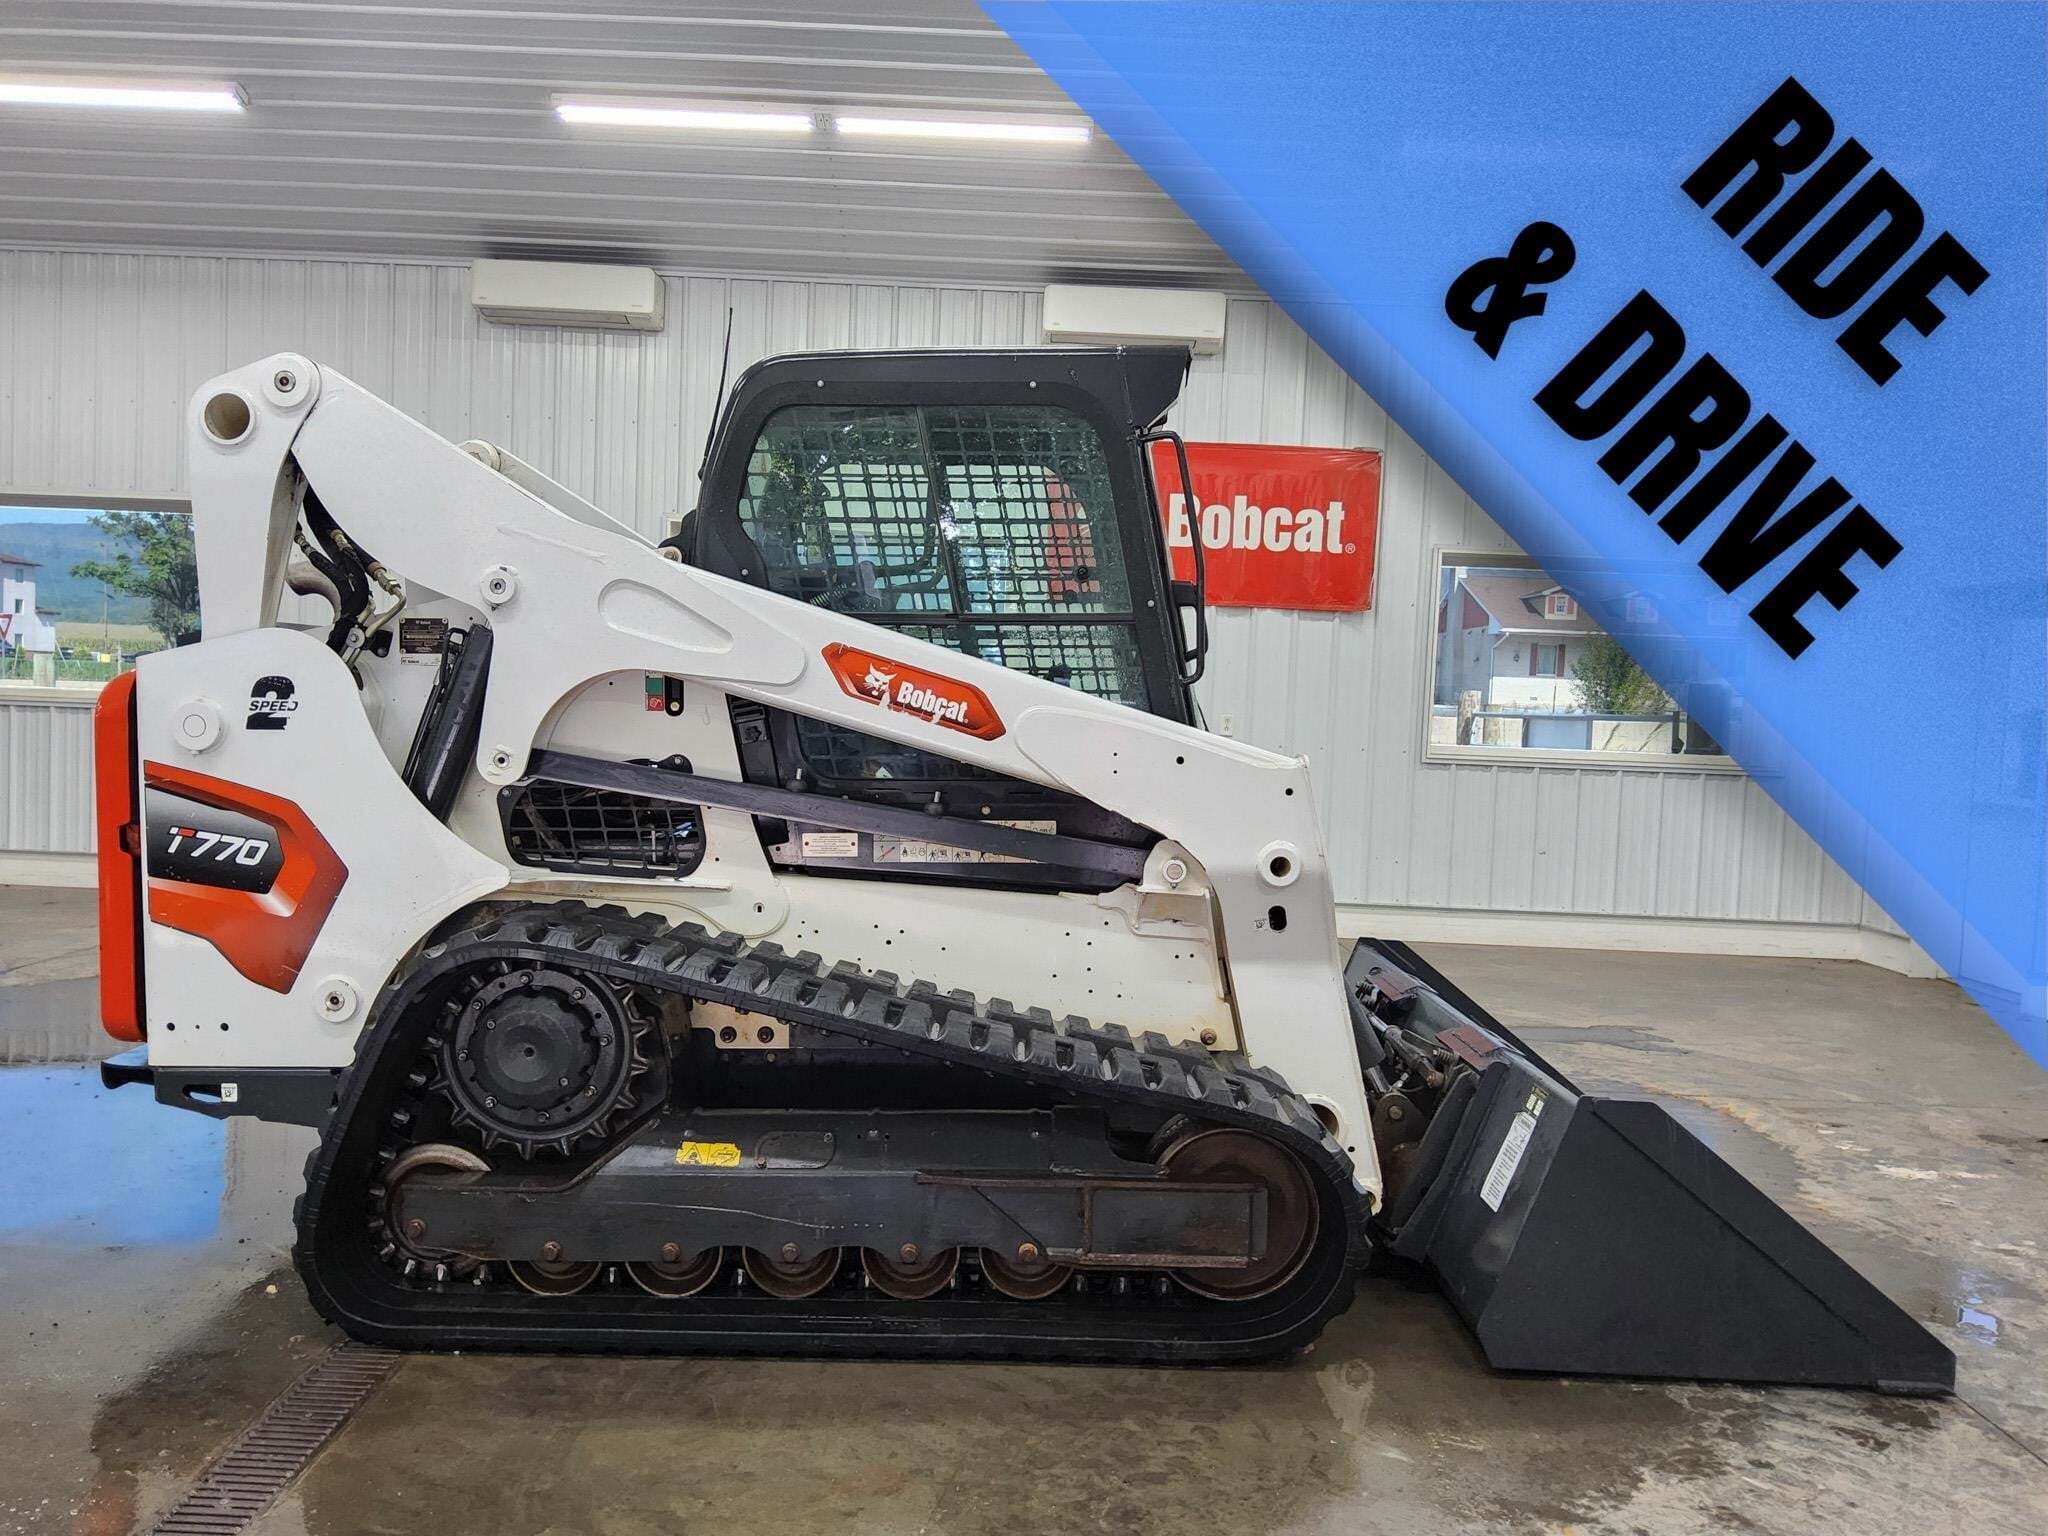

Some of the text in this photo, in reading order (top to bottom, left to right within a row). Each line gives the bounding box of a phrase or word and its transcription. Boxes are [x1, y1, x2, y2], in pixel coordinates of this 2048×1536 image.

[1168, 493, 1345, 554] Bobcat
[246, 676, 295, 730] 2
[896, 680, 968, 723] Bobcat
[167, 827, 270, 866] T770
